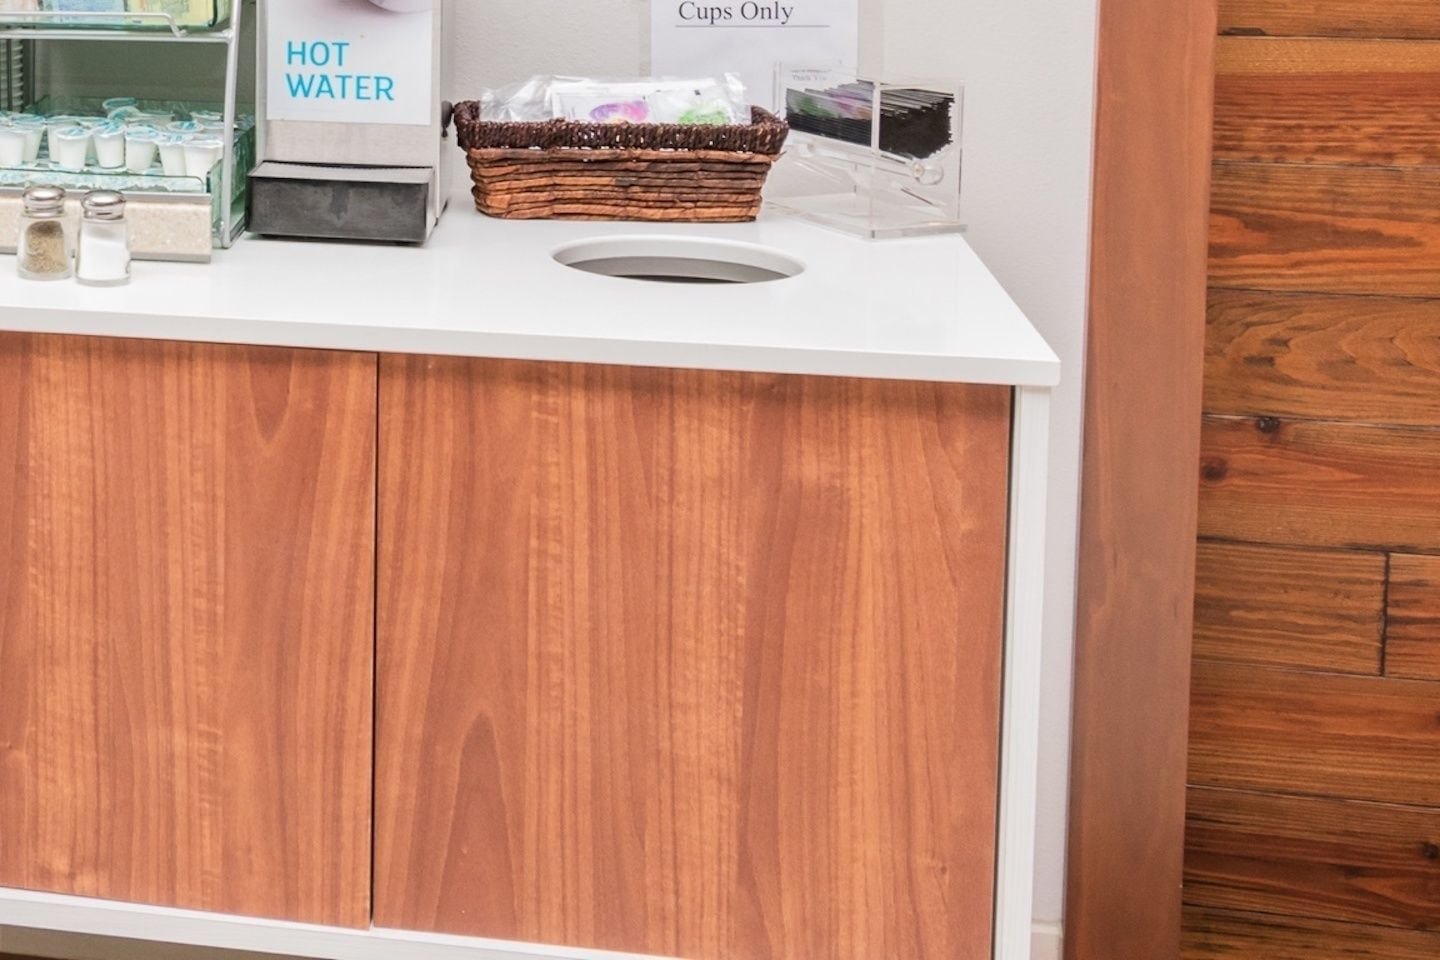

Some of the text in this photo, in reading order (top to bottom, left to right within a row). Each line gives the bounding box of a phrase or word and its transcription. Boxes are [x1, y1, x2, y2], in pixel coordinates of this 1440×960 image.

[678, 0, 794, 25] Cups Only
[286, 41, 350, 67] HOT
[286, 73, 395, 102] WATER
